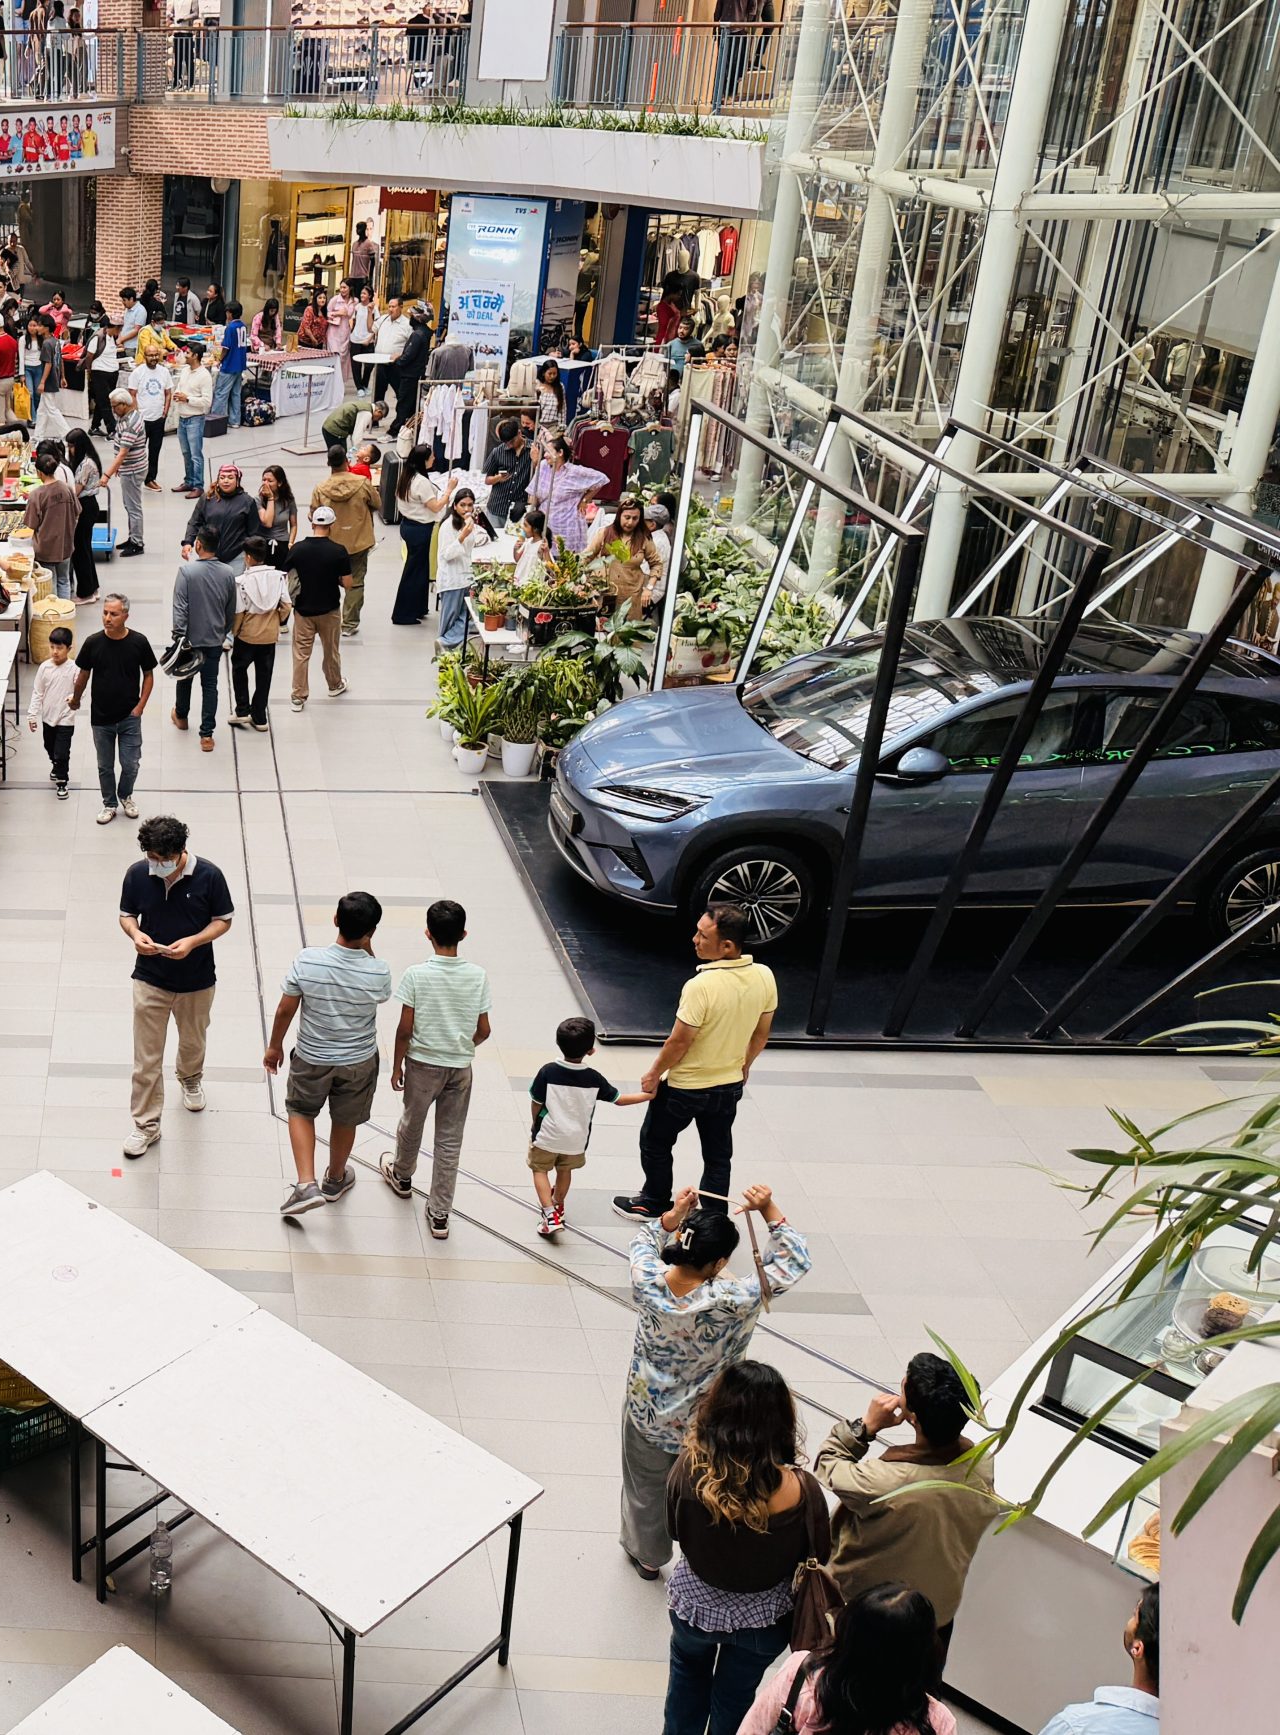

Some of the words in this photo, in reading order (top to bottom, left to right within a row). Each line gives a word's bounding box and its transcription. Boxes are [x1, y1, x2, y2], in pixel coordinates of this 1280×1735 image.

[478, 225, 518, 235] RONIN
[476, 311, 494, 320] DEAL
[236, 326, 246, 347] 10
